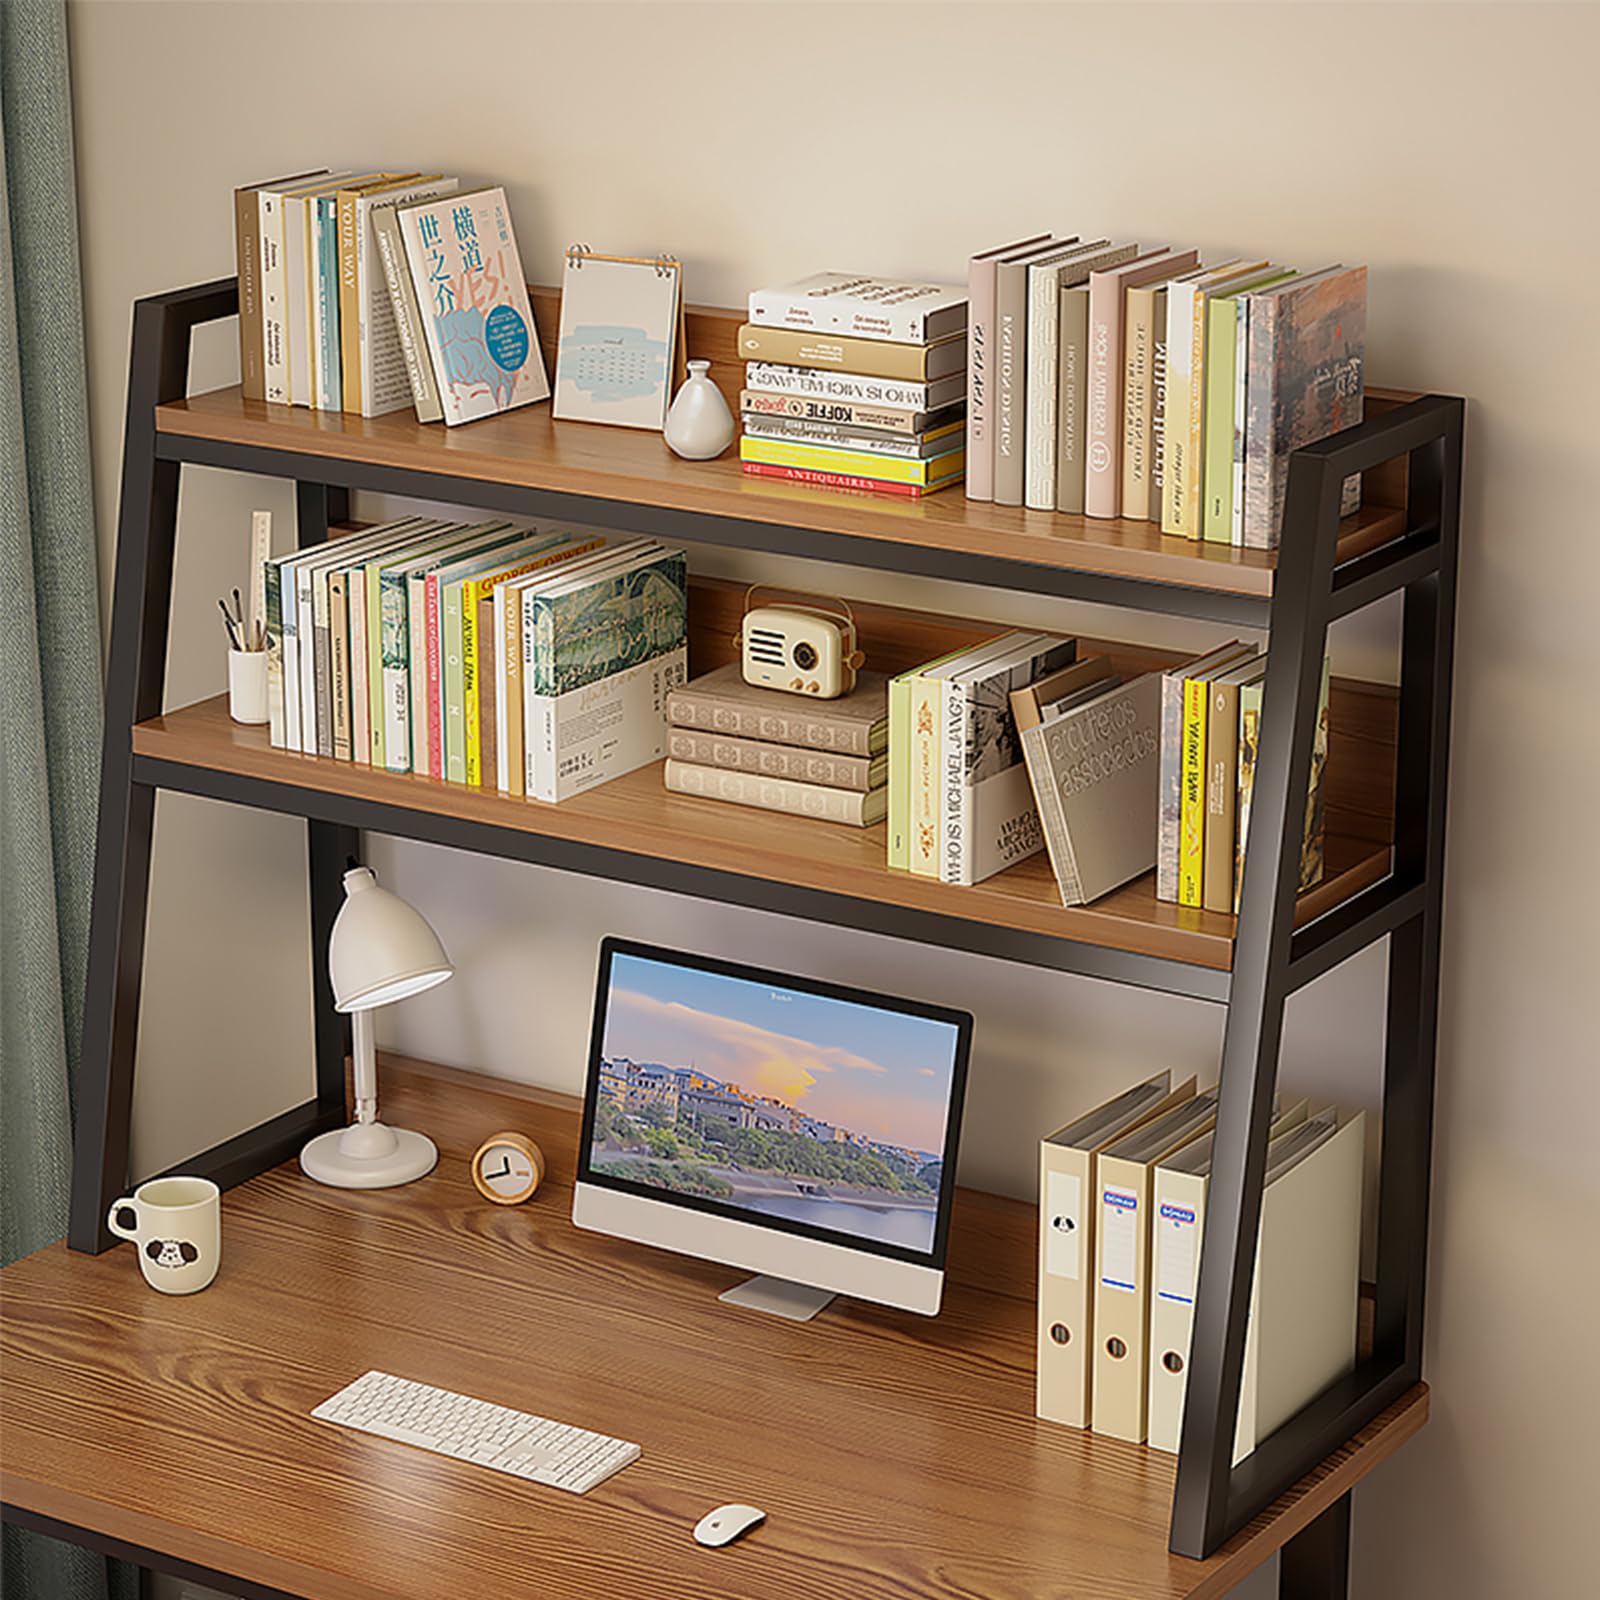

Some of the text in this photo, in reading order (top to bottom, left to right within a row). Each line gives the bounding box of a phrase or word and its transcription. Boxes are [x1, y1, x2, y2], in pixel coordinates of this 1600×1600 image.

[341, 203, 356, 288] YOUR WAY
[418, 212, 454, 317] 世之介
[798, 377, 863, 398] MICHAEL
[866, 386, 882, 400] IS
[885, 388, 922, 405] WHO
[806, 402, 853, 422] KOFFIE
[785, 469, 875, 490] ANTIQUAIRES
[506, 597, 518, 679] YOUR WAY
[947, 695, 963, 884] WHO IS MICHAEL JANG?
